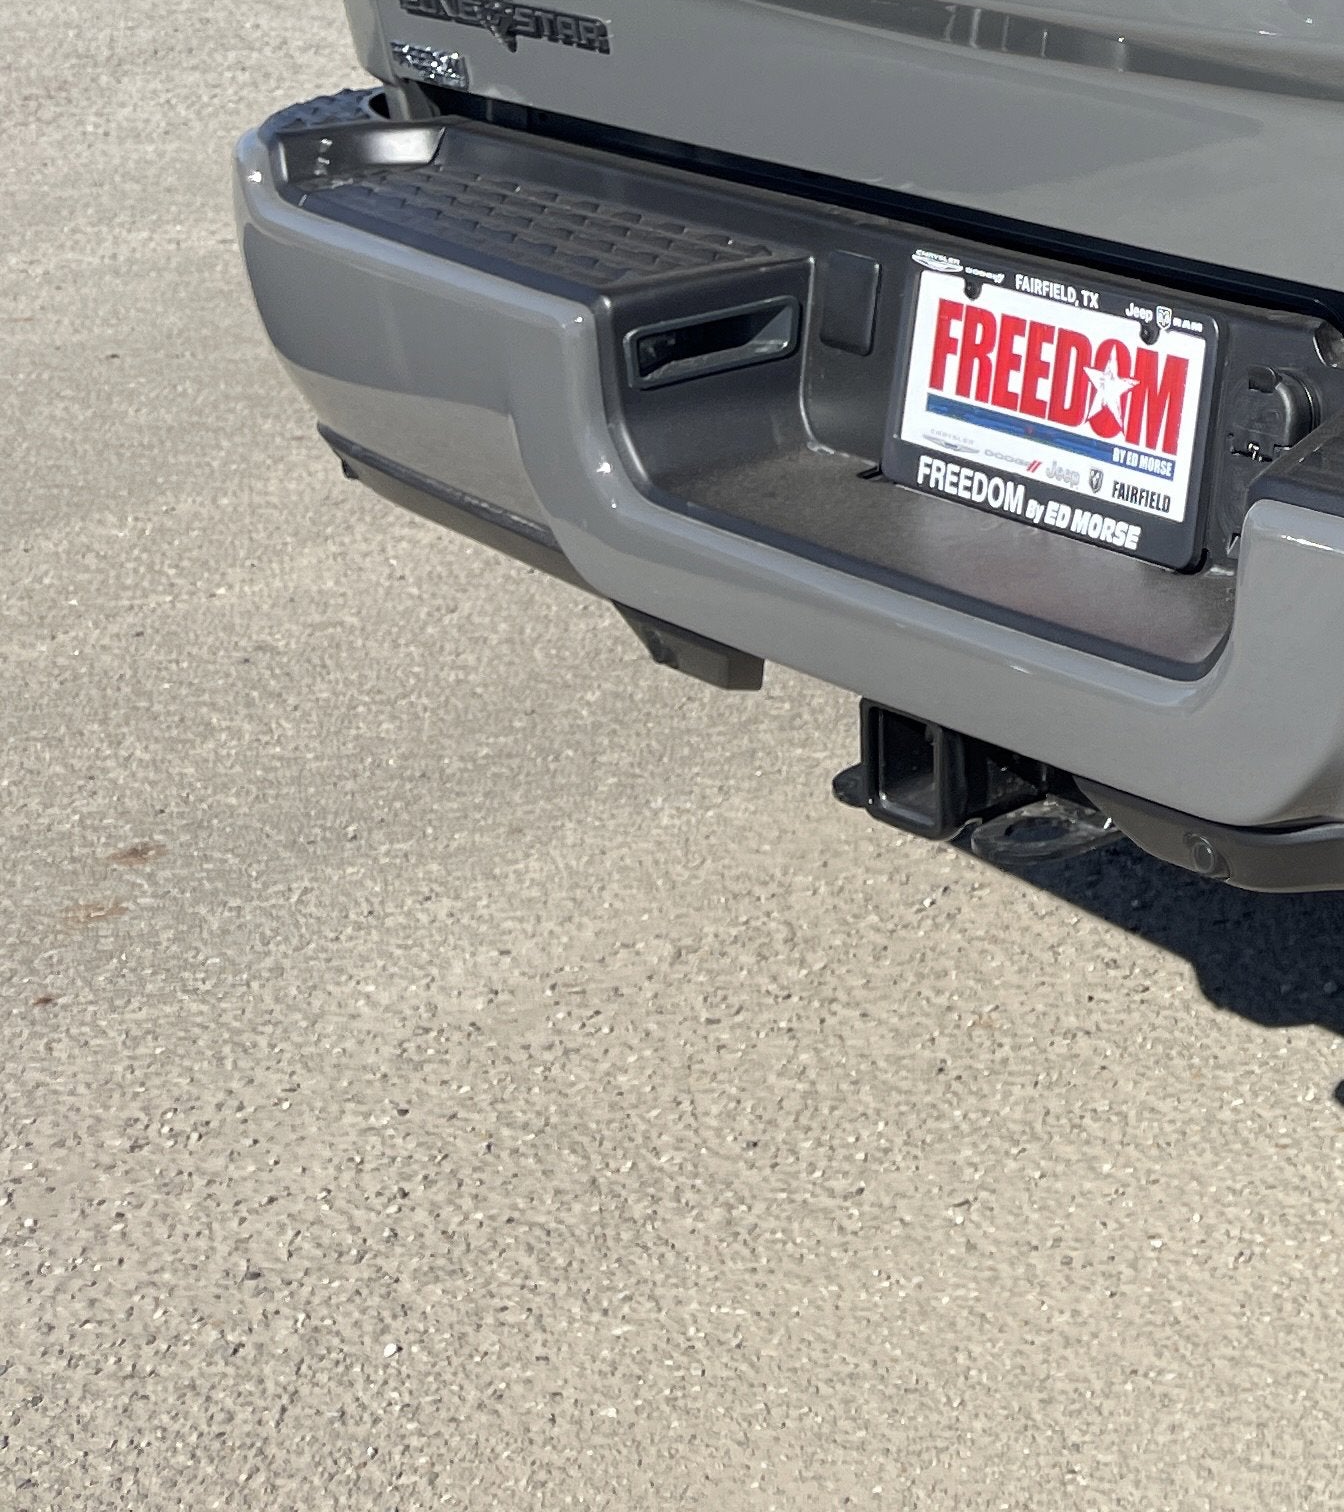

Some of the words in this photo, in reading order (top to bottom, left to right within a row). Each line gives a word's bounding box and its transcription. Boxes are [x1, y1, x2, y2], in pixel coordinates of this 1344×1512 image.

[512, 3, 612, 55] STAR
[1014, 273, 1079, 307] FAIRFIELD,
[1081, 290, 1100, 309] TX
[1125, 302, 1153, 323] Jeep
[1173, 317, 1203, 333] RAM
[929, 298, 1189, 456] FREEDOM
[1046, 461, 1081, 488] Jeep
[1112, 447, 1126, 464] BY
[1126, 451, 1139, 468] ED
[1139, 454, 1173, 477] MORSE
[917, 455, 1026, 516] FREEDOM
[1044, 500, 1072, 529] ED
[1070, 508, 1142, 551] MORSE
[1112, 480, 1171, 514] FAIRFIELD
